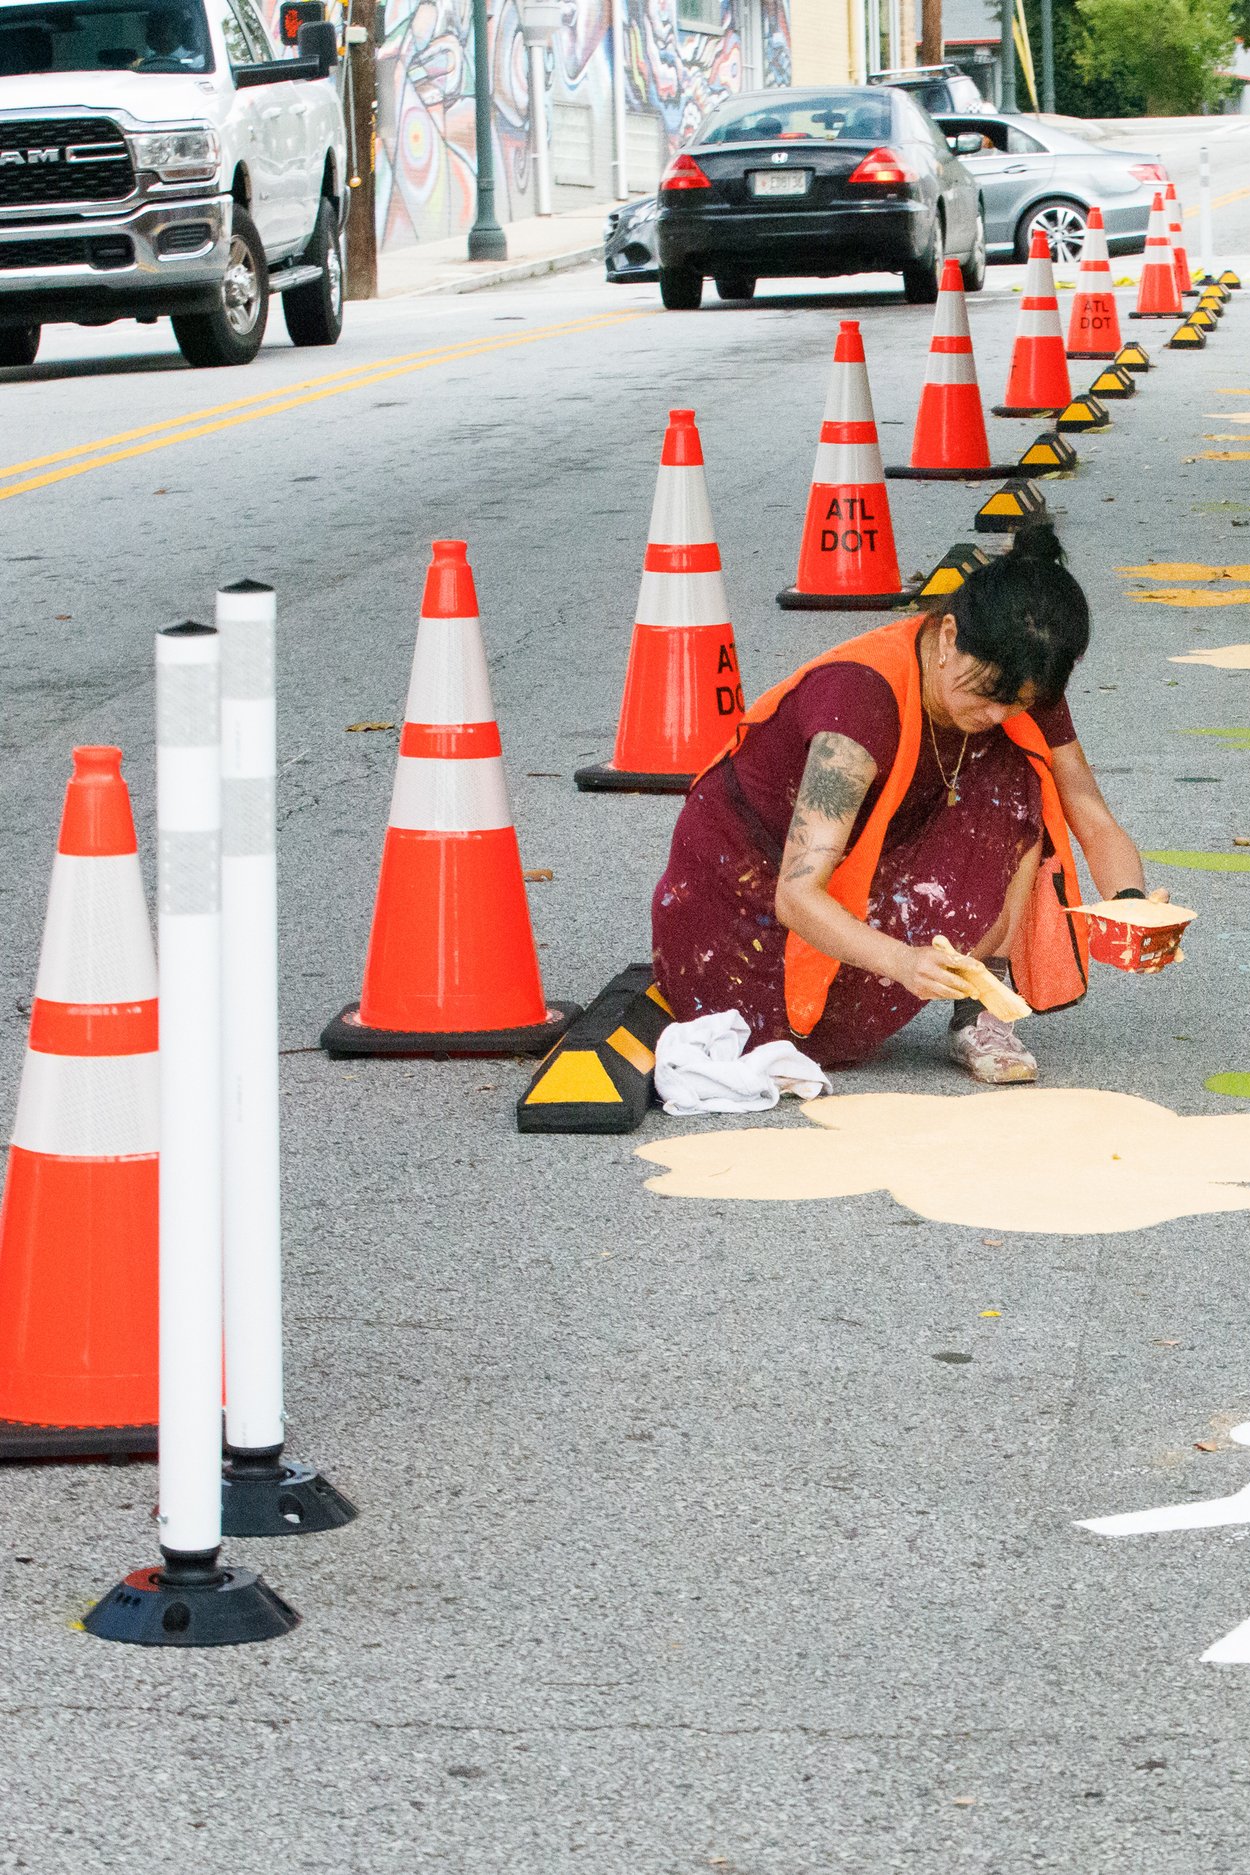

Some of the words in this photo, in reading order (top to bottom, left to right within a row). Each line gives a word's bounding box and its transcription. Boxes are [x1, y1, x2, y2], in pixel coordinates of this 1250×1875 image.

[1084, 300, 1109, 312] ATL
[1080, 317, 1111, 329] DOT
[826, 498, 874, 520] ATL
[821, 529, 878, 552] DOT
